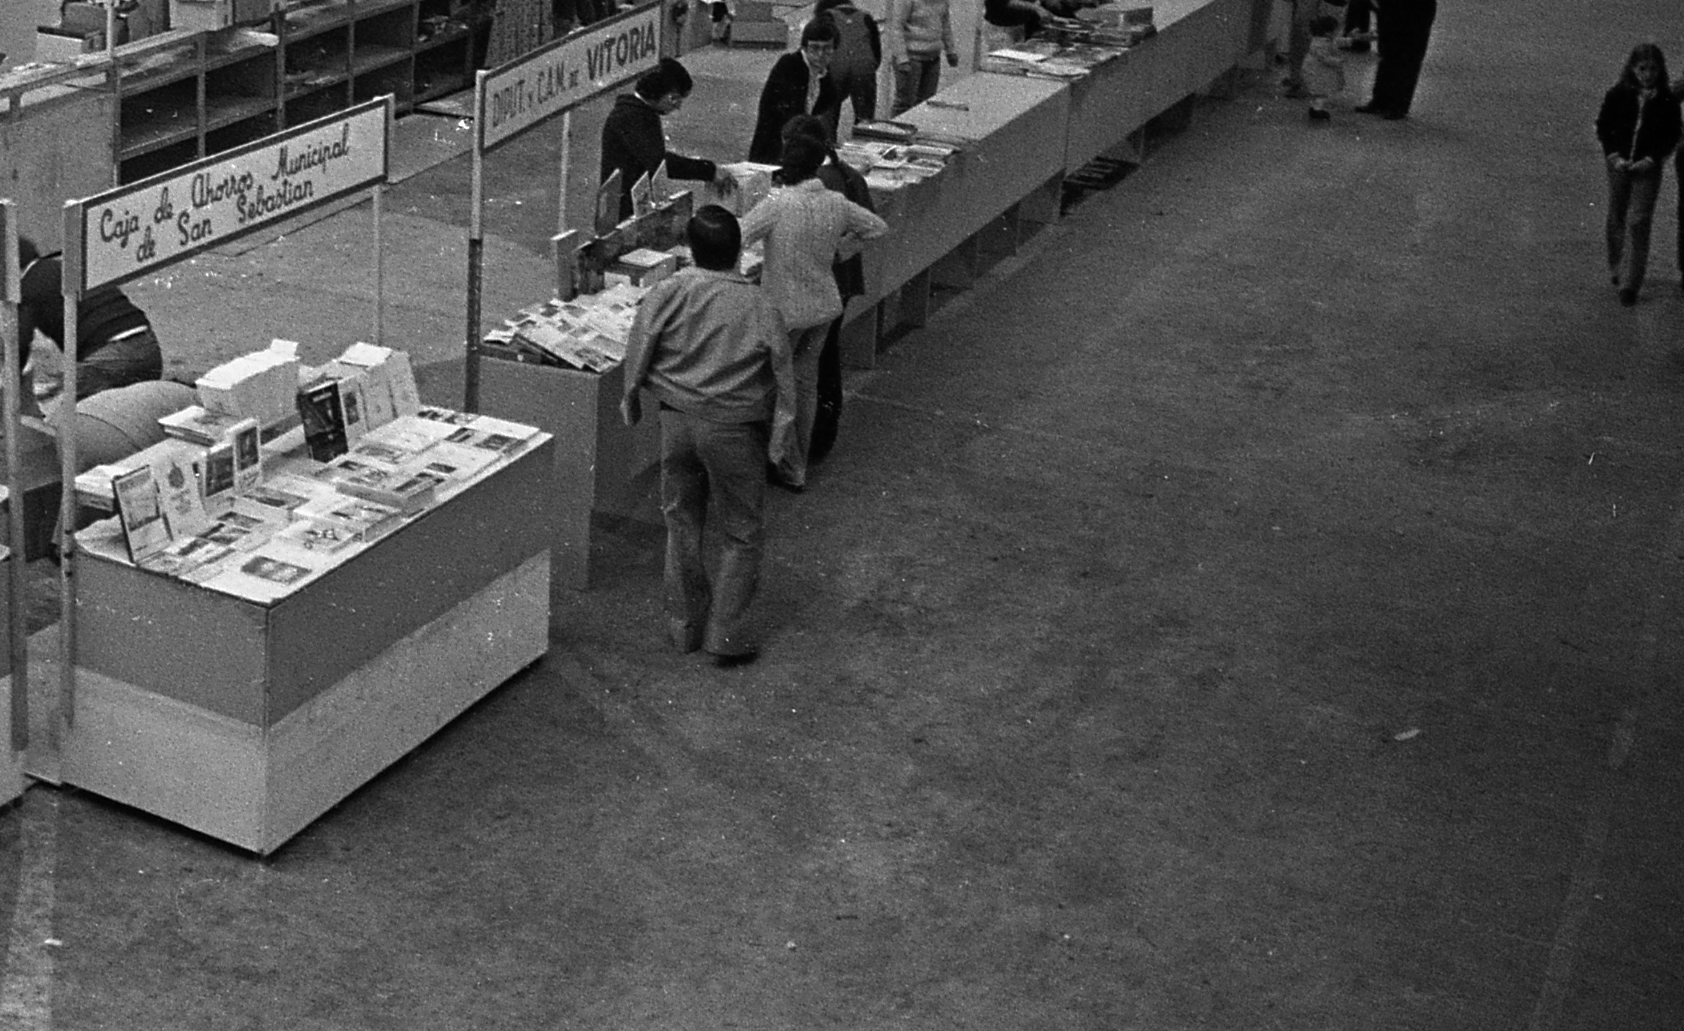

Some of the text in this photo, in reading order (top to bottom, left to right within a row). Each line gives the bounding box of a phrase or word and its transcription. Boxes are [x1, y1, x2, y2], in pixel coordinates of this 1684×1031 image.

[587, 21, 657, 81] VITORIA
[100, 122, 351, 249] Caja de Ahorros Municipal
[136, 179, 314, 263] de San Sebastian
